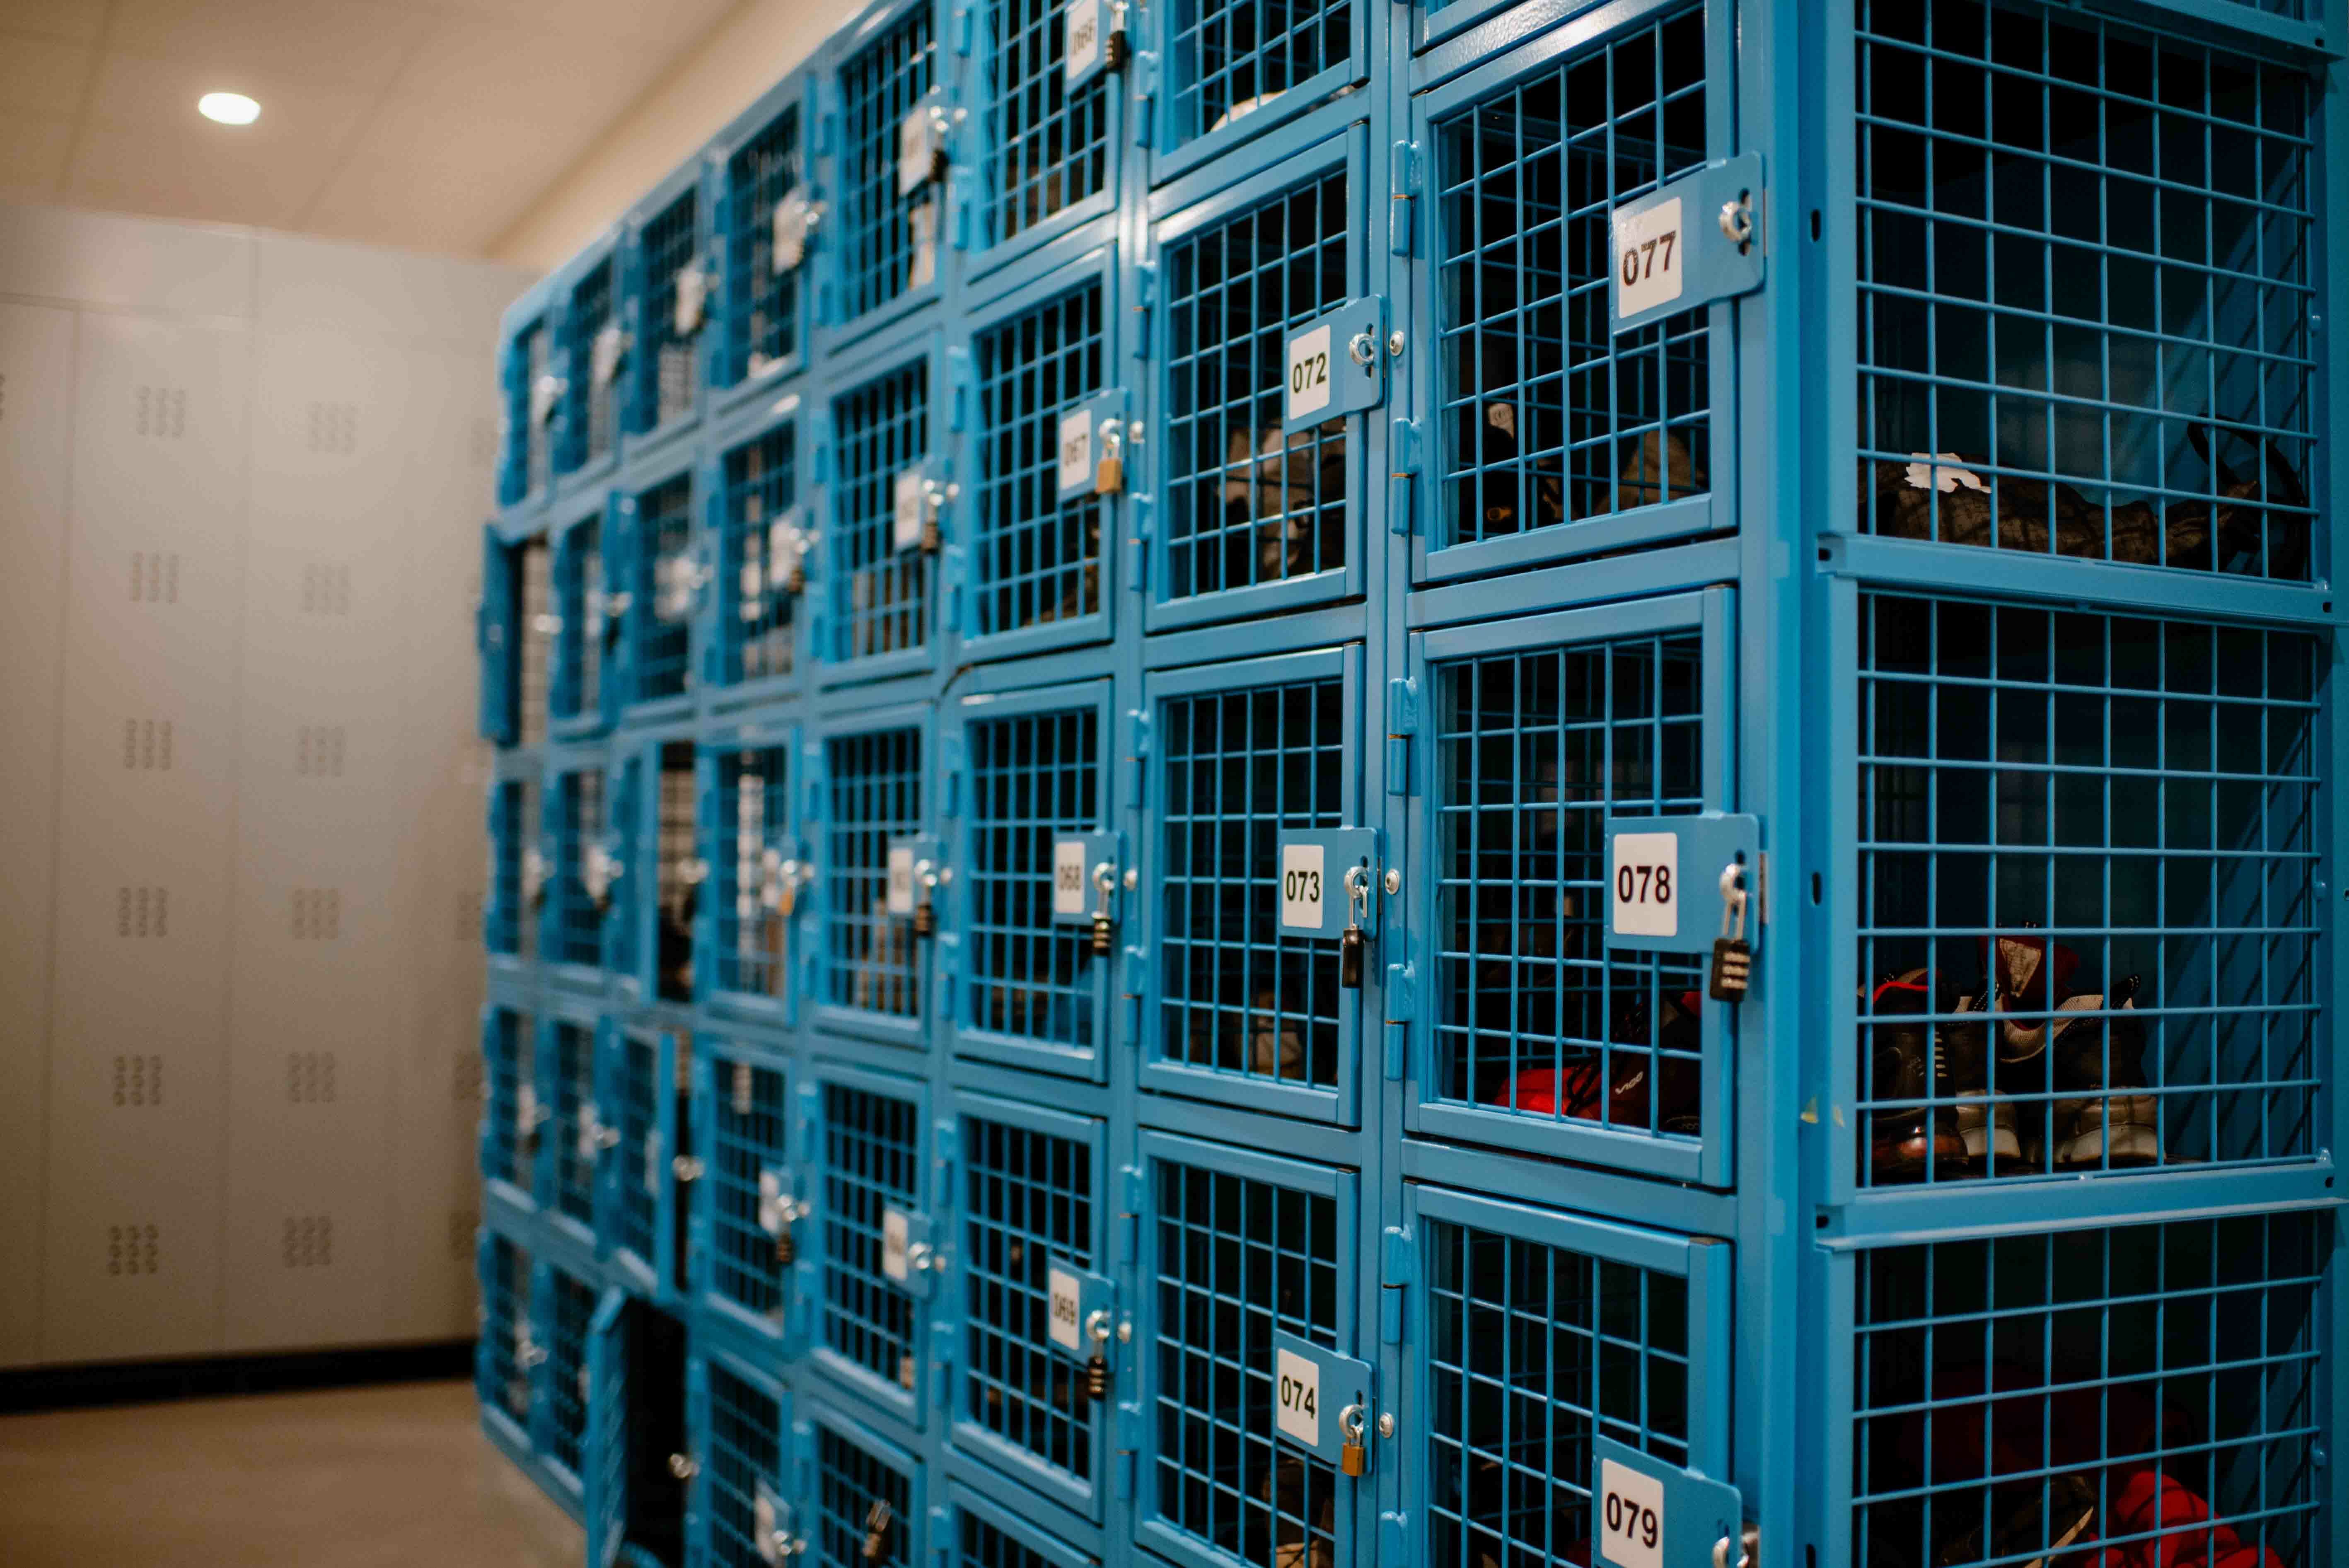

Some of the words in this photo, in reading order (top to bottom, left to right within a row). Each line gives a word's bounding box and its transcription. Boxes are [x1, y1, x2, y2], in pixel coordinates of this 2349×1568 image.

[1623, 230, 1676, 287] 077
[1293, 352, 1326, 394] 072
[1286, 870, 1320, 903] 073
[1619, 864, 1672, 904] 078
[1281, 1375, 1316, 1419] 074
[1606, 1491, 1659, 1549] 079
